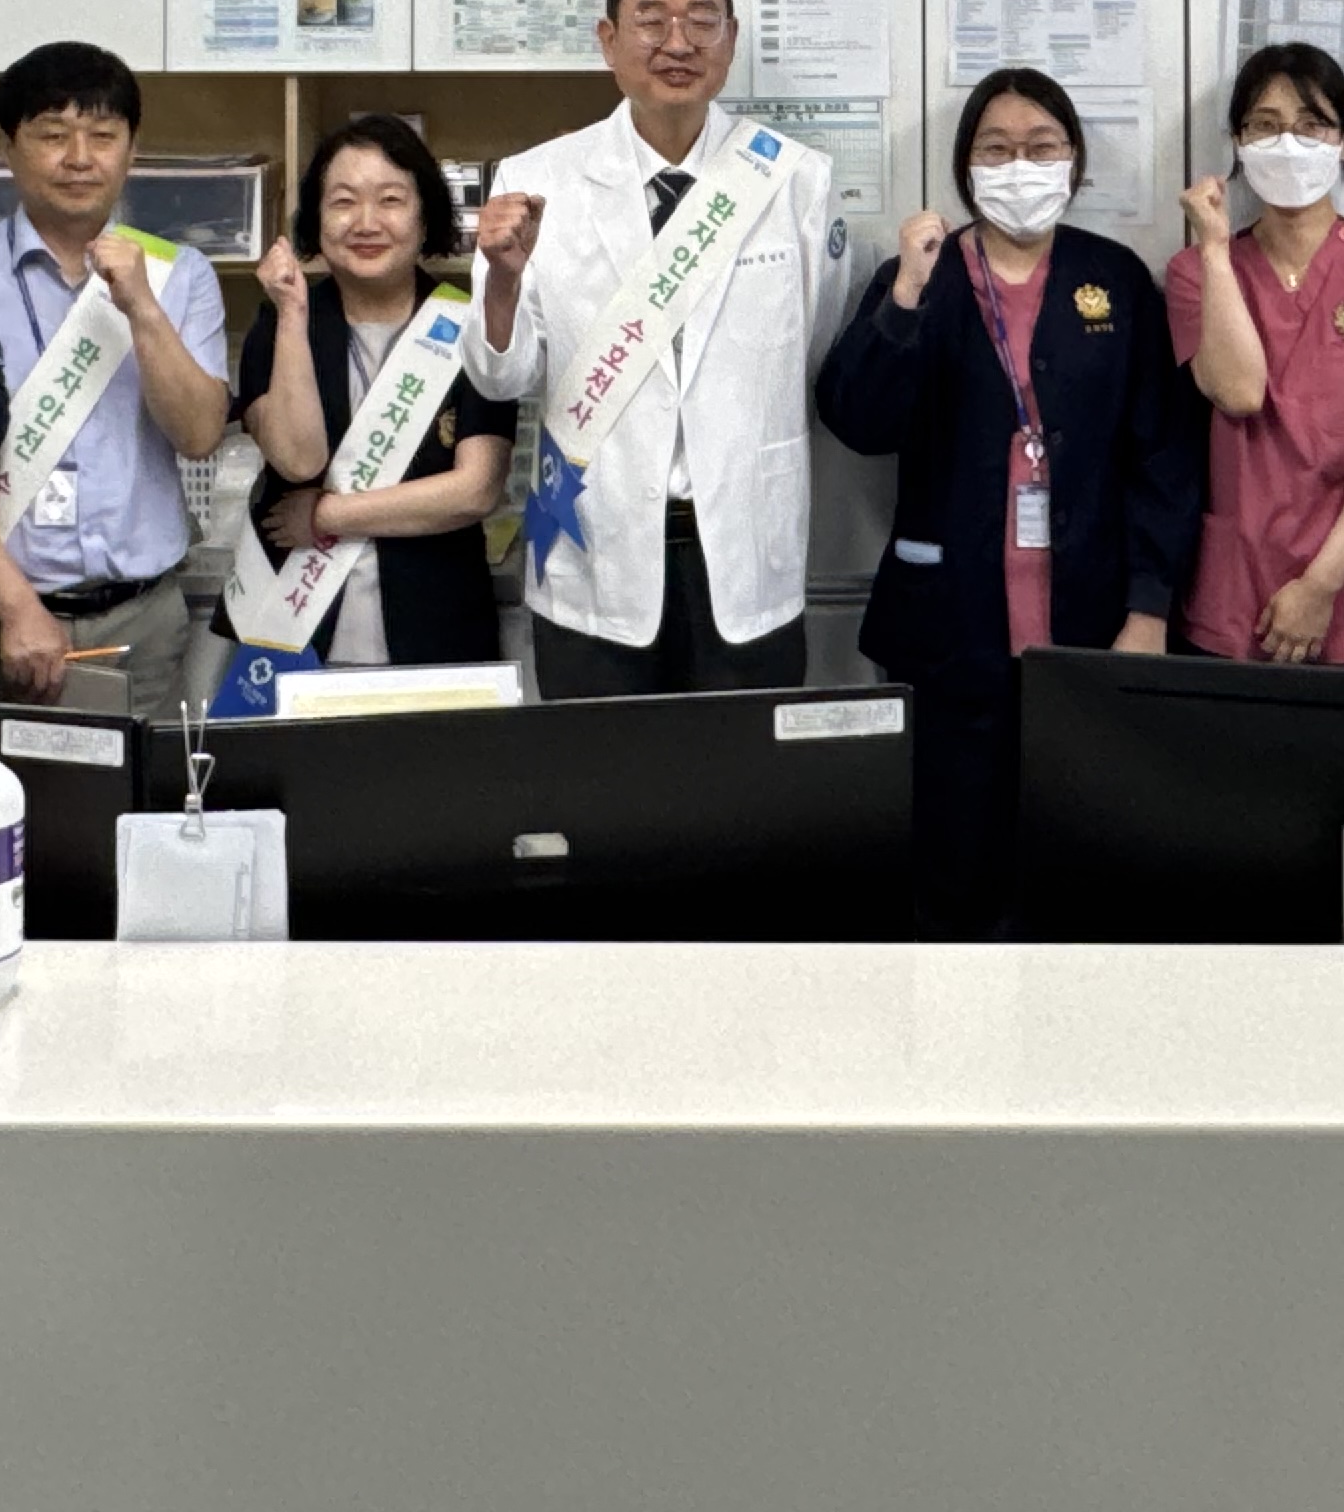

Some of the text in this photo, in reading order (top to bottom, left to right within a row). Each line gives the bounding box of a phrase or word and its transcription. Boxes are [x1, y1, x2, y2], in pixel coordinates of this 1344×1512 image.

[15, 336, 102, 462] 환자안전
[567, 191, 737, 430] 환자안전 수호천사
